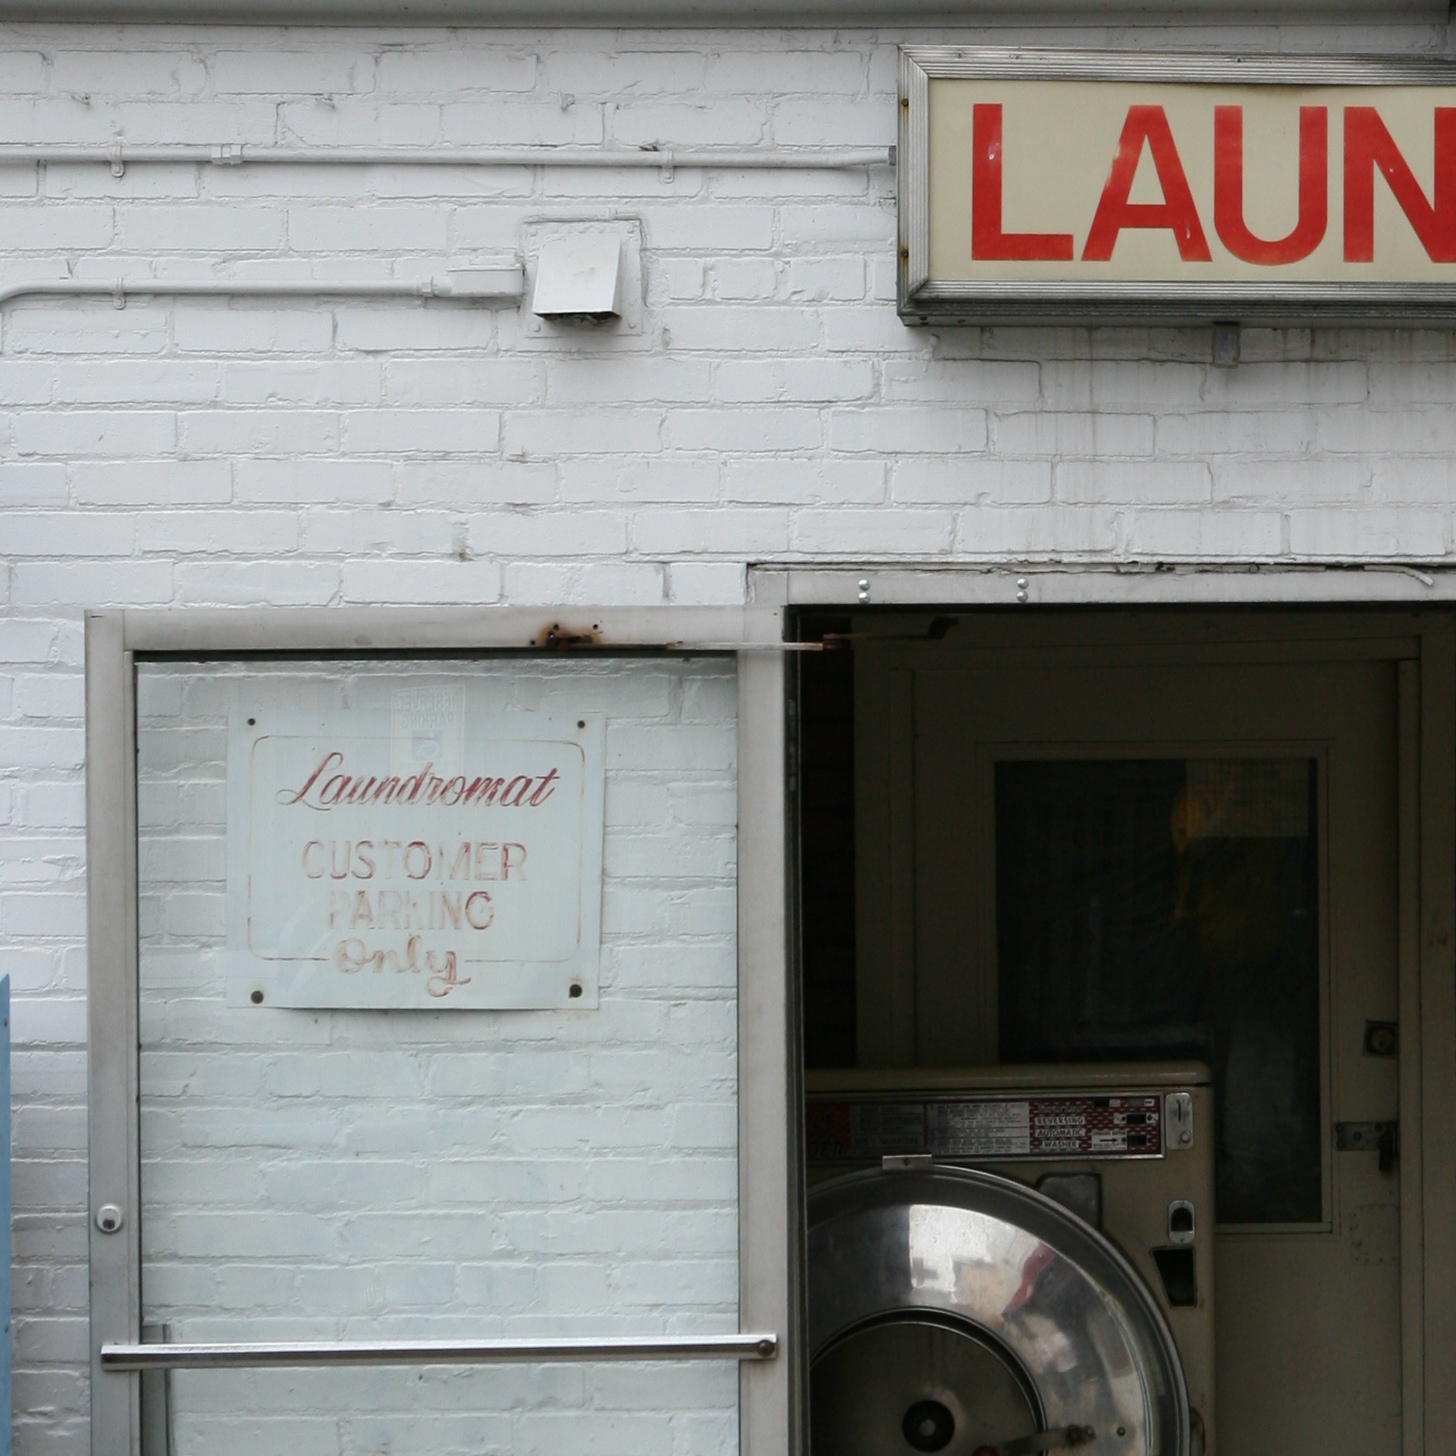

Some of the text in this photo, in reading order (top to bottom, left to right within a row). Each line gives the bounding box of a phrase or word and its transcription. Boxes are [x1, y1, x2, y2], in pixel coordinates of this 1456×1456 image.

[275, 751, 560, 811] Laundromat
[302, 841, 528, 881] CUSTOMER
[329, 890, 494, 930] PARKING
[334, 935, 471, 998] Only
